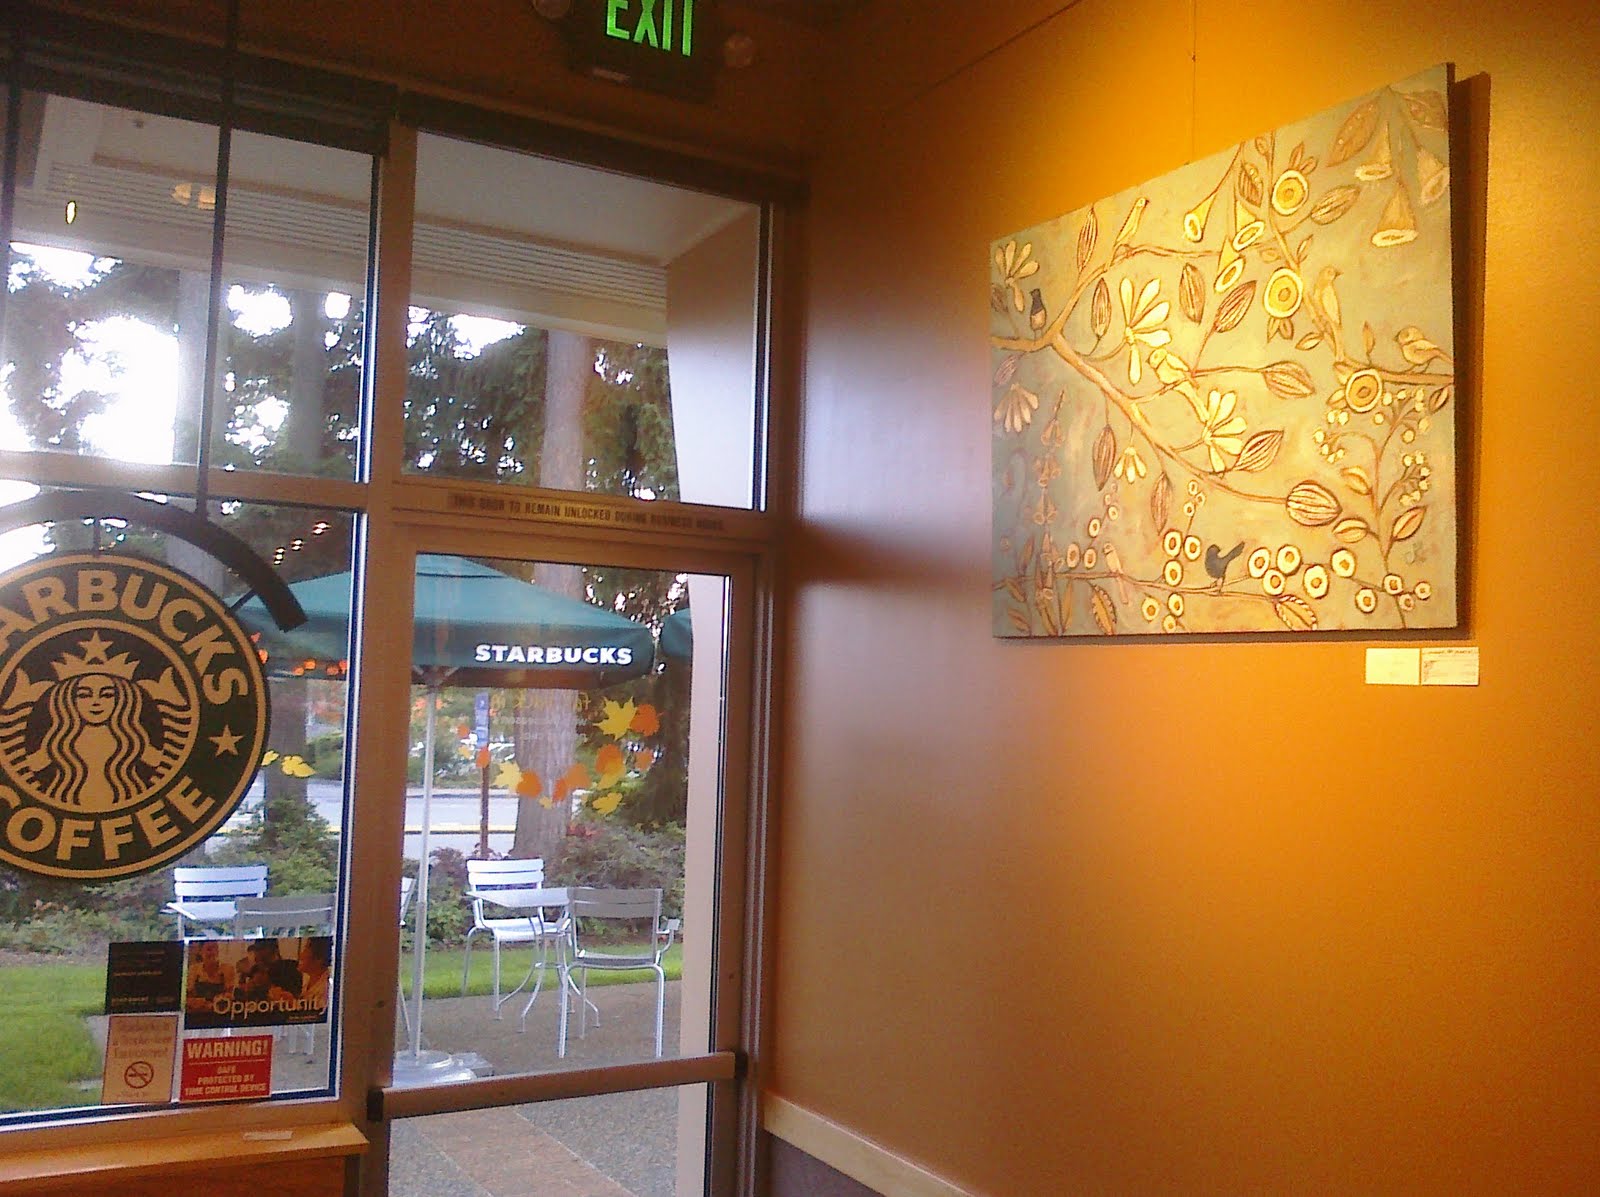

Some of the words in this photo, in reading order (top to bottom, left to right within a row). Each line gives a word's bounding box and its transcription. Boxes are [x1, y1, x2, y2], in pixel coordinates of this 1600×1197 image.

[509, 499, 521, 513] TO
[525, 501, 560, 517] REMAIN
[564, 503, 611, 521] UNLOCKED
[475, 644, 633, 665] STARBUCKS
[213, 994, 326, 1021] Opportunity
[187, 1039, 269, 1059] WARNING!
[185, 1086, 204, 1095] TIME
[204, 1084, 239, 1094] CONTROL
[240, 1083, 267, 1092] DEVICE
[197, 1075, 243, 1085] PROTECTED
[243, 1073, 255, 1082] BY
